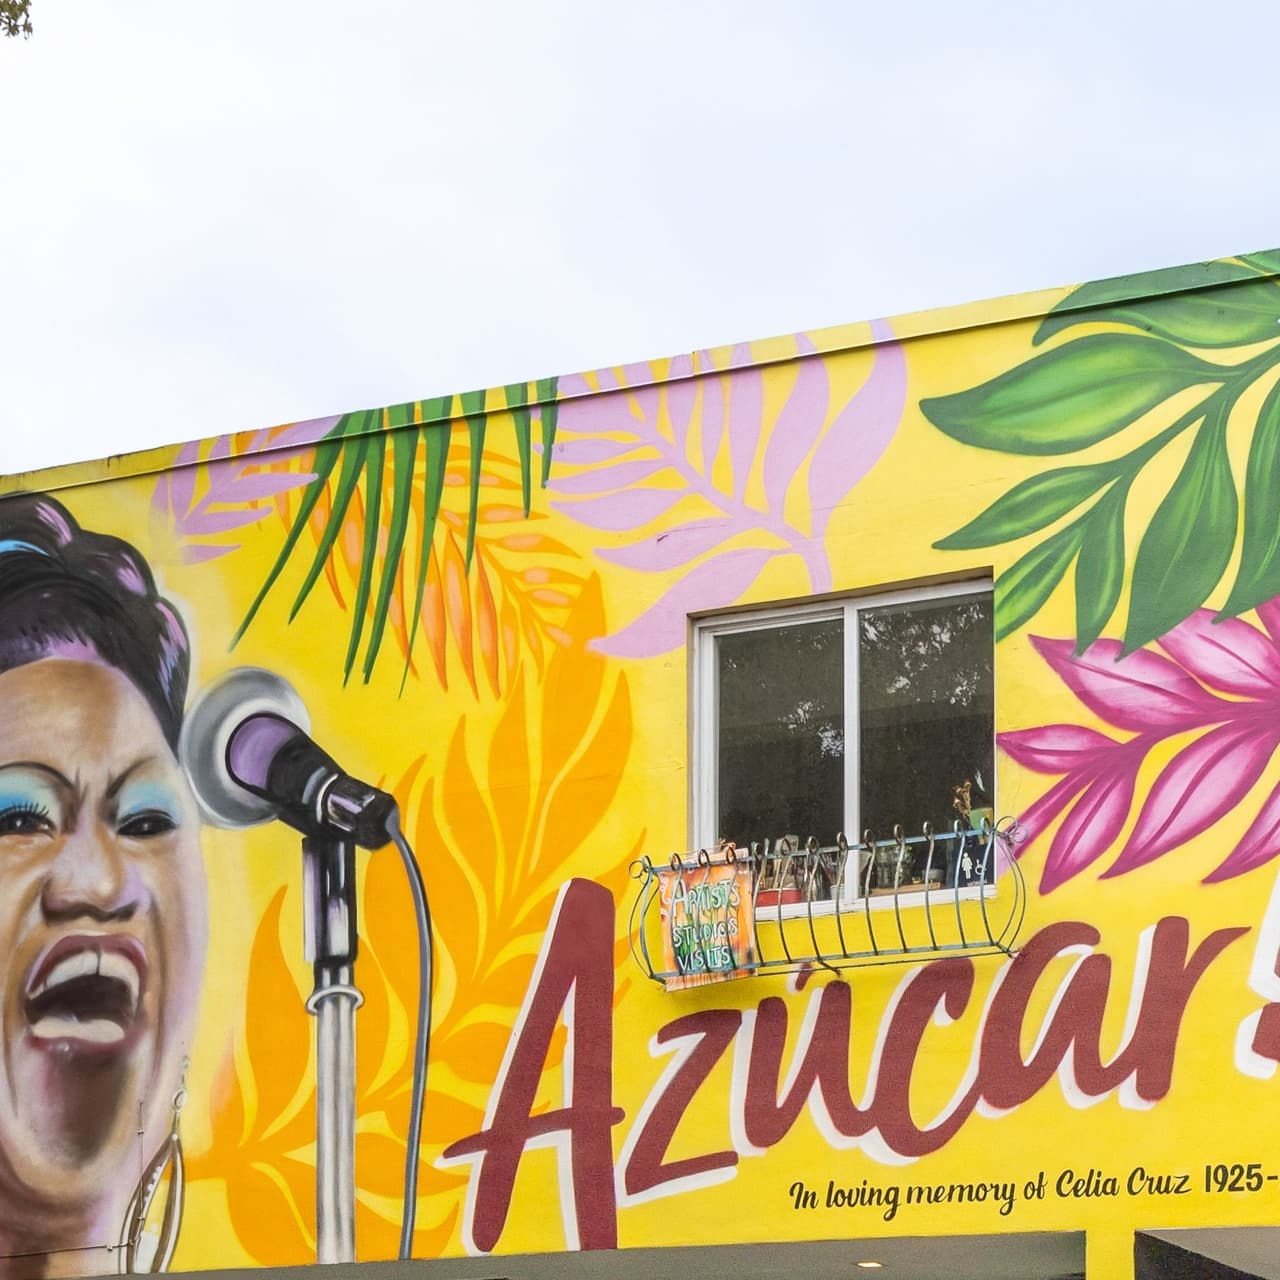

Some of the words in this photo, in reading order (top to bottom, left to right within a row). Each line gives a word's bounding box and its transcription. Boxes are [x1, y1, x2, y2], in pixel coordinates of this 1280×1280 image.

[677, 946, 731, 970] VISITS
[788, 1181, 819, 1209] In
[825, 1179, 901, 1221] loving
[906, 1182, 1017, 1216] memory
[1023, 1171, 1048, 1200] of
[1055, 1168, 1120, 1198] Celia
[1126, 1166, 1192, 1196] Cruz
